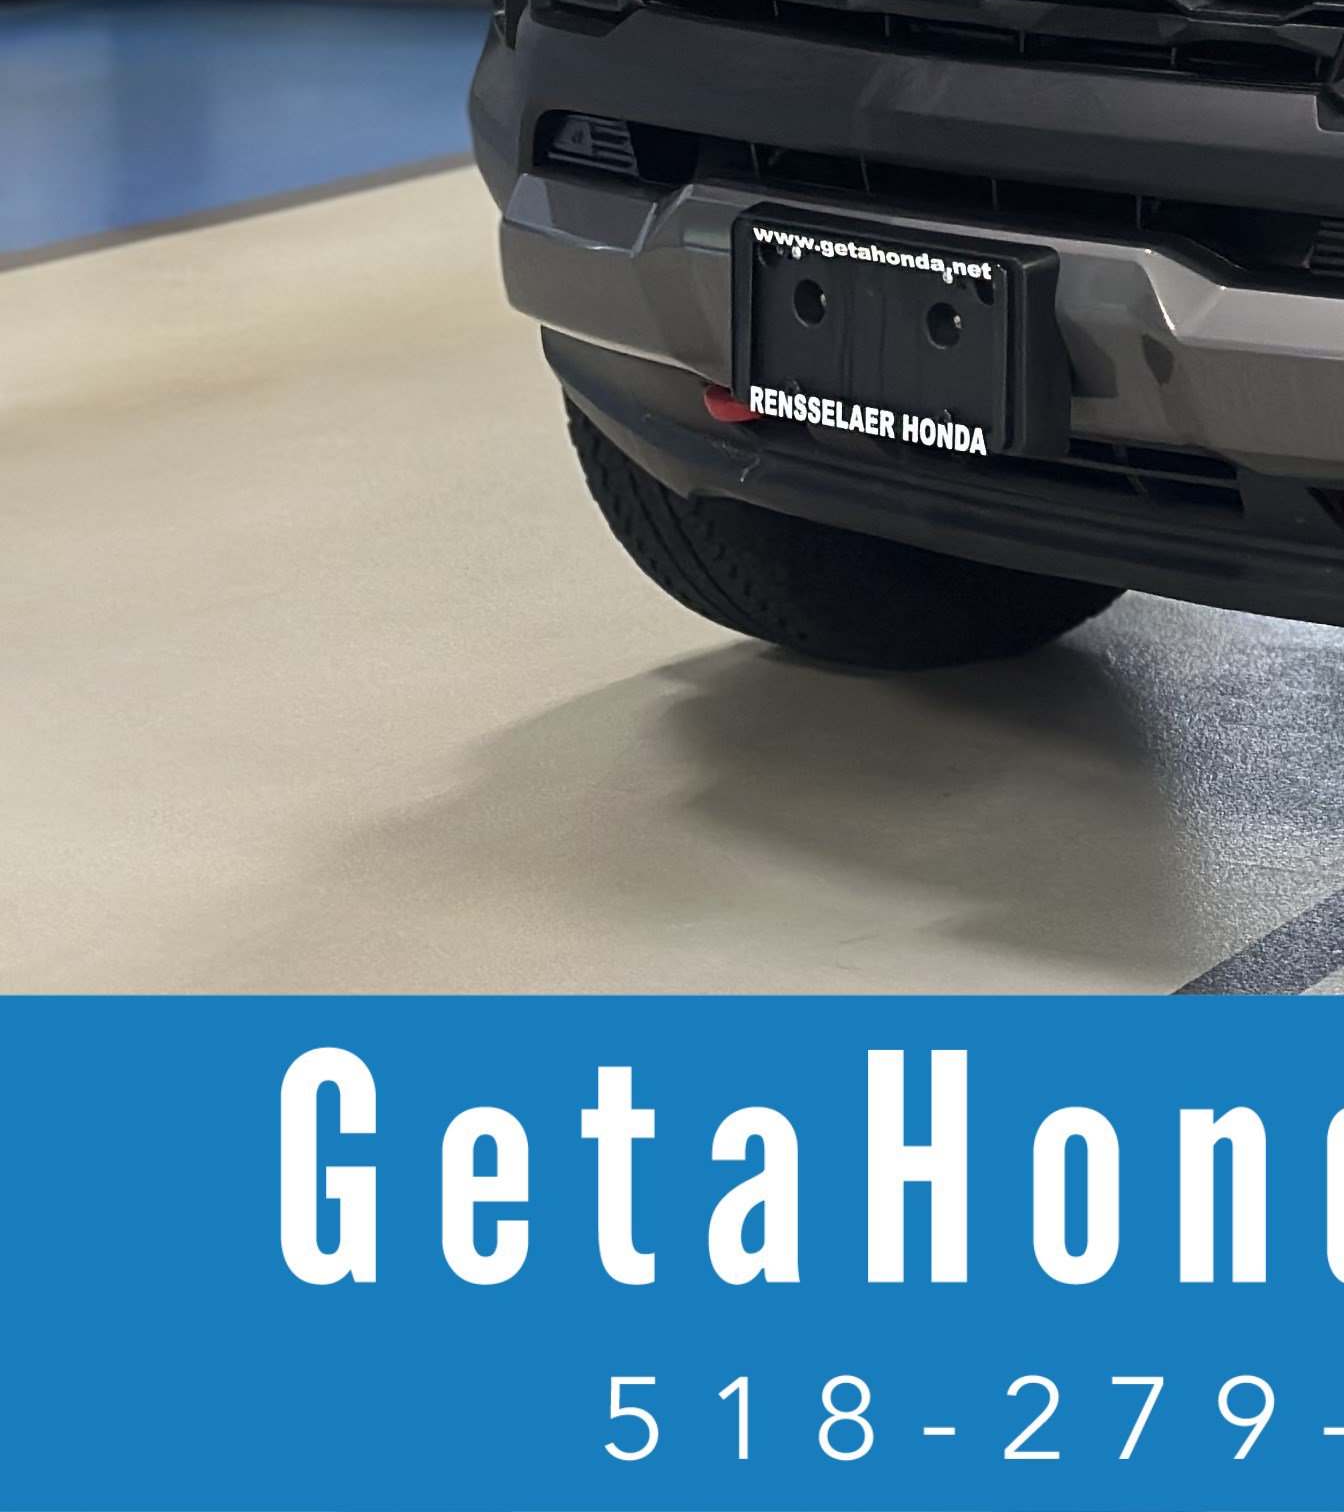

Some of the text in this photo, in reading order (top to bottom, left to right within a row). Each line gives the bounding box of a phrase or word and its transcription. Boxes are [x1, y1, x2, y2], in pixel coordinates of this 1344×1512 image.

[752, 226, 993, 281] www.getahonda.net
[750, 385, 987, 456] RENSSELAER HONDA
